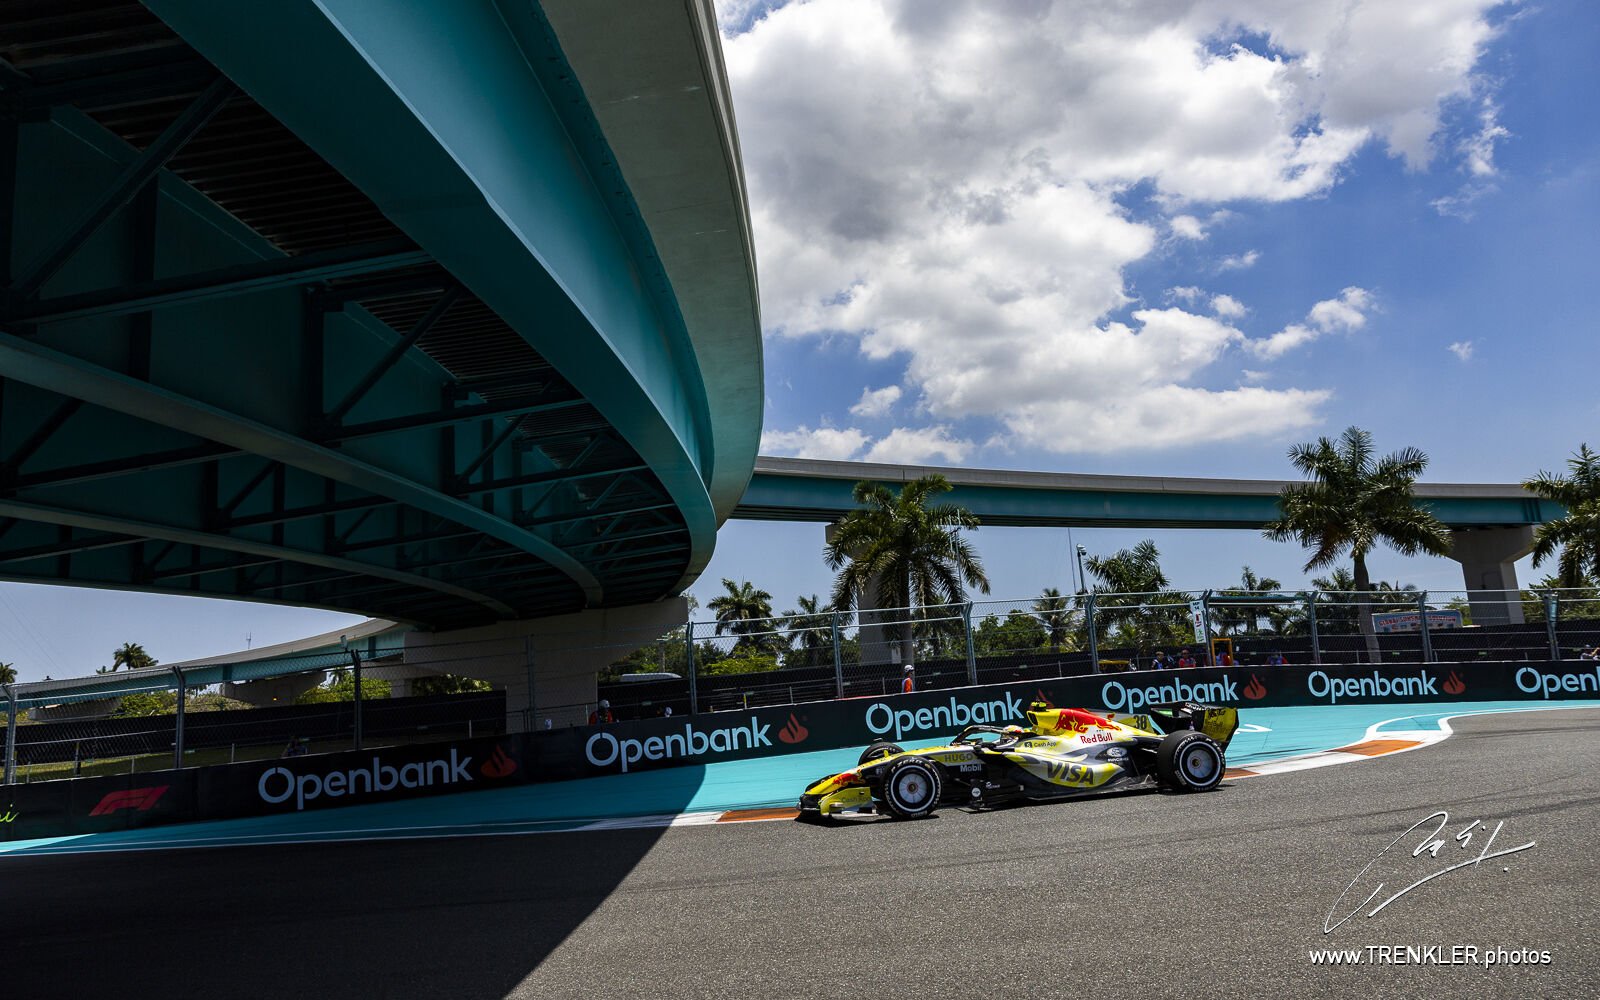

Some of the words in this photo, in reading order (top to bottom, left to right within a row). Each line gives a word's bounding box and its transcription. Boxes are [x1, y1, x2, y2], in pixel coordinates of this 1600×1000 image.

[1101, 674, 1240, 714] Openbank
[1308, 670, 1439, 704] Openbank
[1515, 665, 1600, 699] Open
[865, 691, 1023, 741] Openbank
[585, 716, 773, 773] Openbank
[1080, 734, 1097, 744] Red
[1097, 732, 1113, 742] Bull
[944, 753, 973, 762] HUGO
[960, 764, 982, 772] Mobil
[1046, 760, 1094, 785] VISA
[258, 748, 474, 810] Openbank
